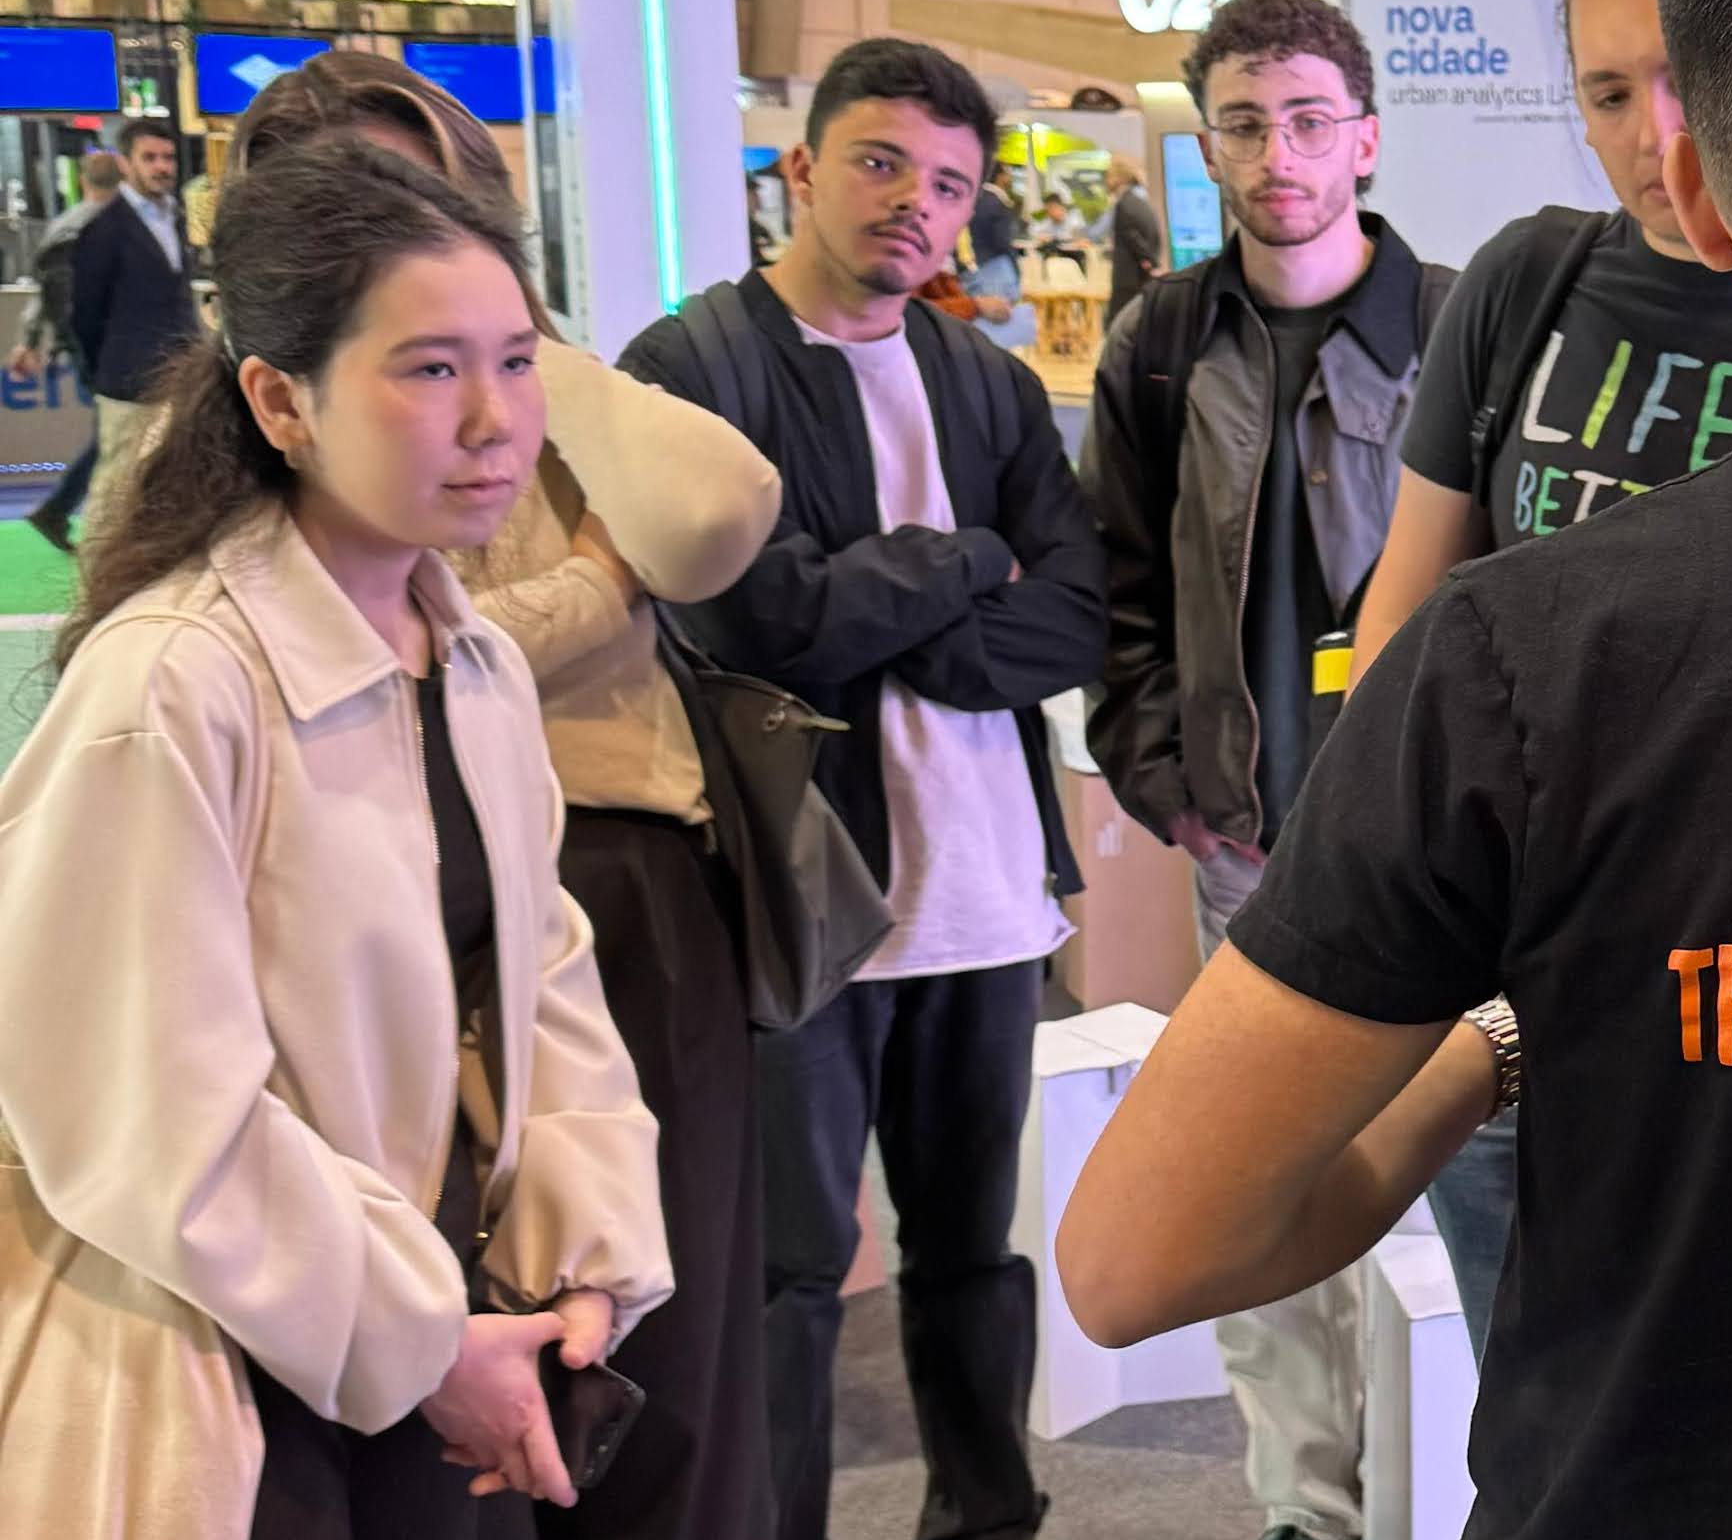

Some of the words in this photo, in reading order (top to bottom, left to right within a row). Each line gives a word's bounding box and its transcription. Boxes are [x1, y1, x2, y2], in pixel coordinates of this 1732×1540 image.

[1386, 4, 1475, 34] nova
[1385, 36, 1510, 76] cidade
[1387, 82, 1448, 106] urban
